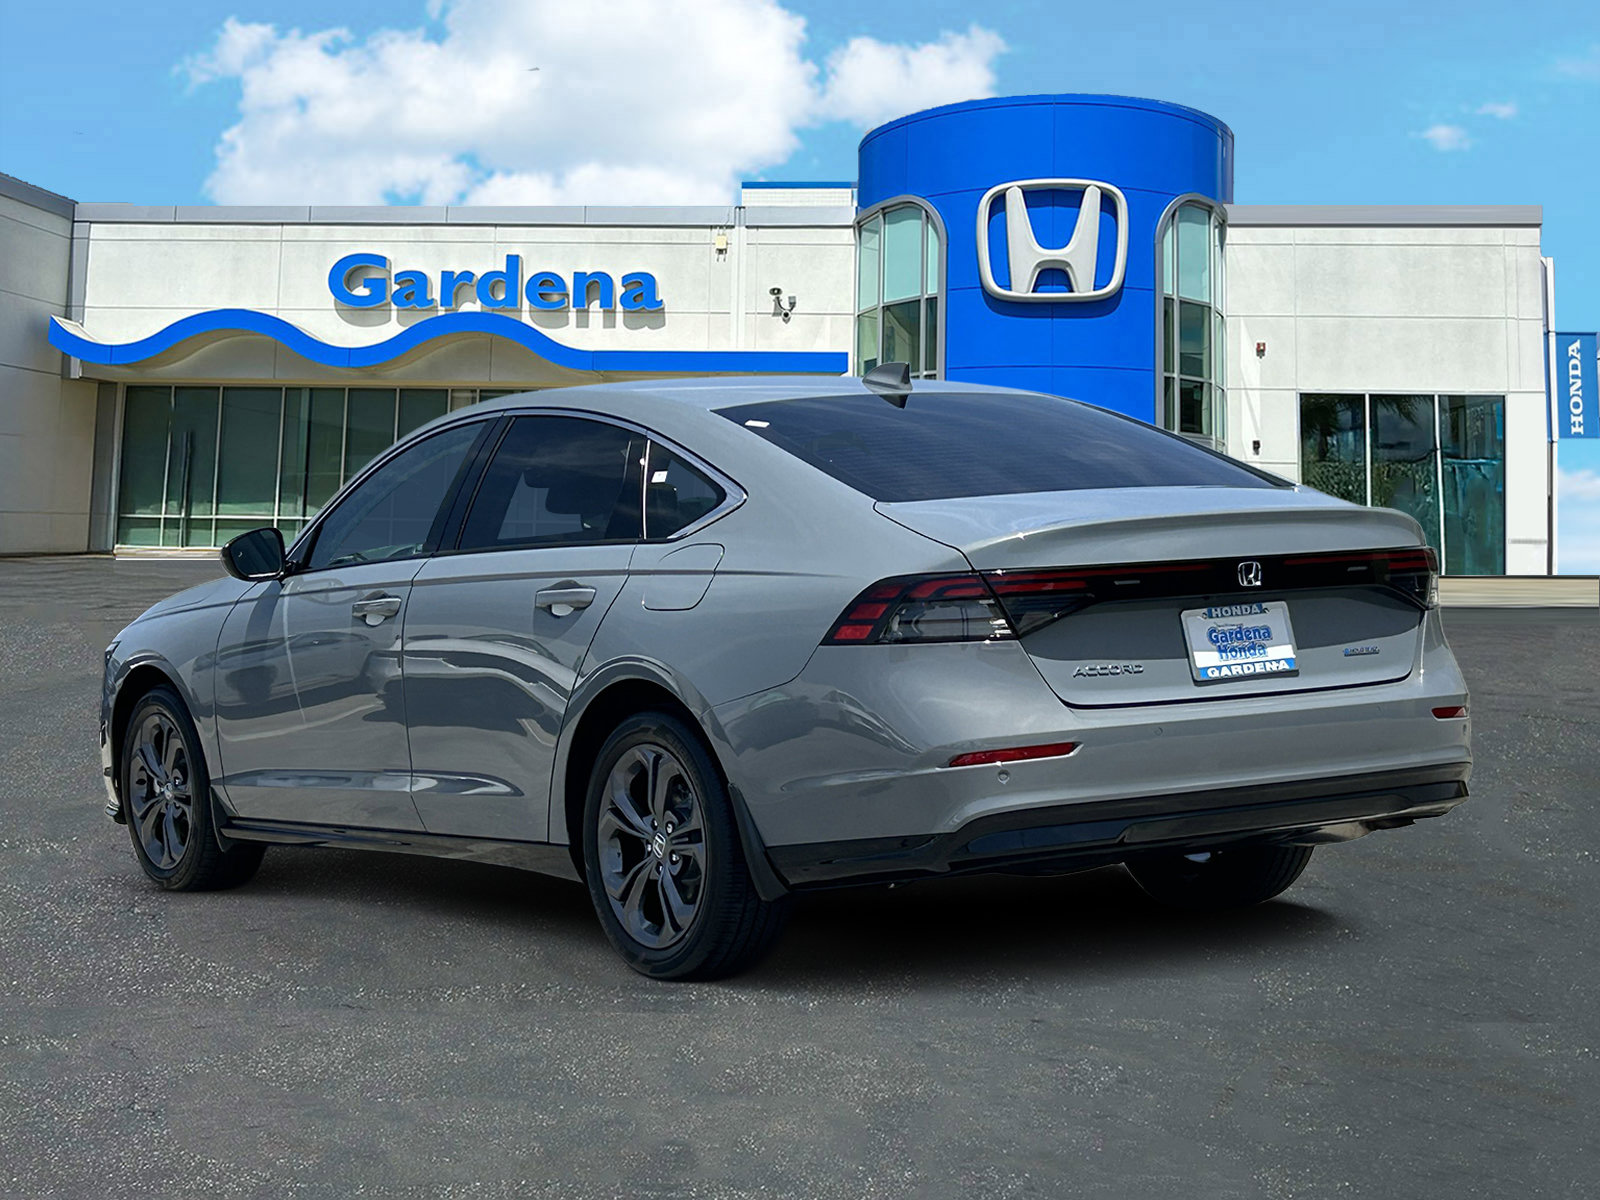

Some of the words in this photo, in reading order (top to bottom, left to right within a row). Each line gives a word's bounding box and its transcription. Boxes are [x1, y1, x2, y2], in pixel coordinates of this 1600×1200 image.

[328, 252, 663, 310] Gardena
[1568, 338, 1584, 436] HONDA
[1211, 604, 1261, 618] HONDA
[1207, 624, 1272, 645] Gardena
[1216, 641, 1268, 661] Honda
[1072, 664, 1144, 679] ACCORD
[1206, 659, 1290, 678] GARDENA
